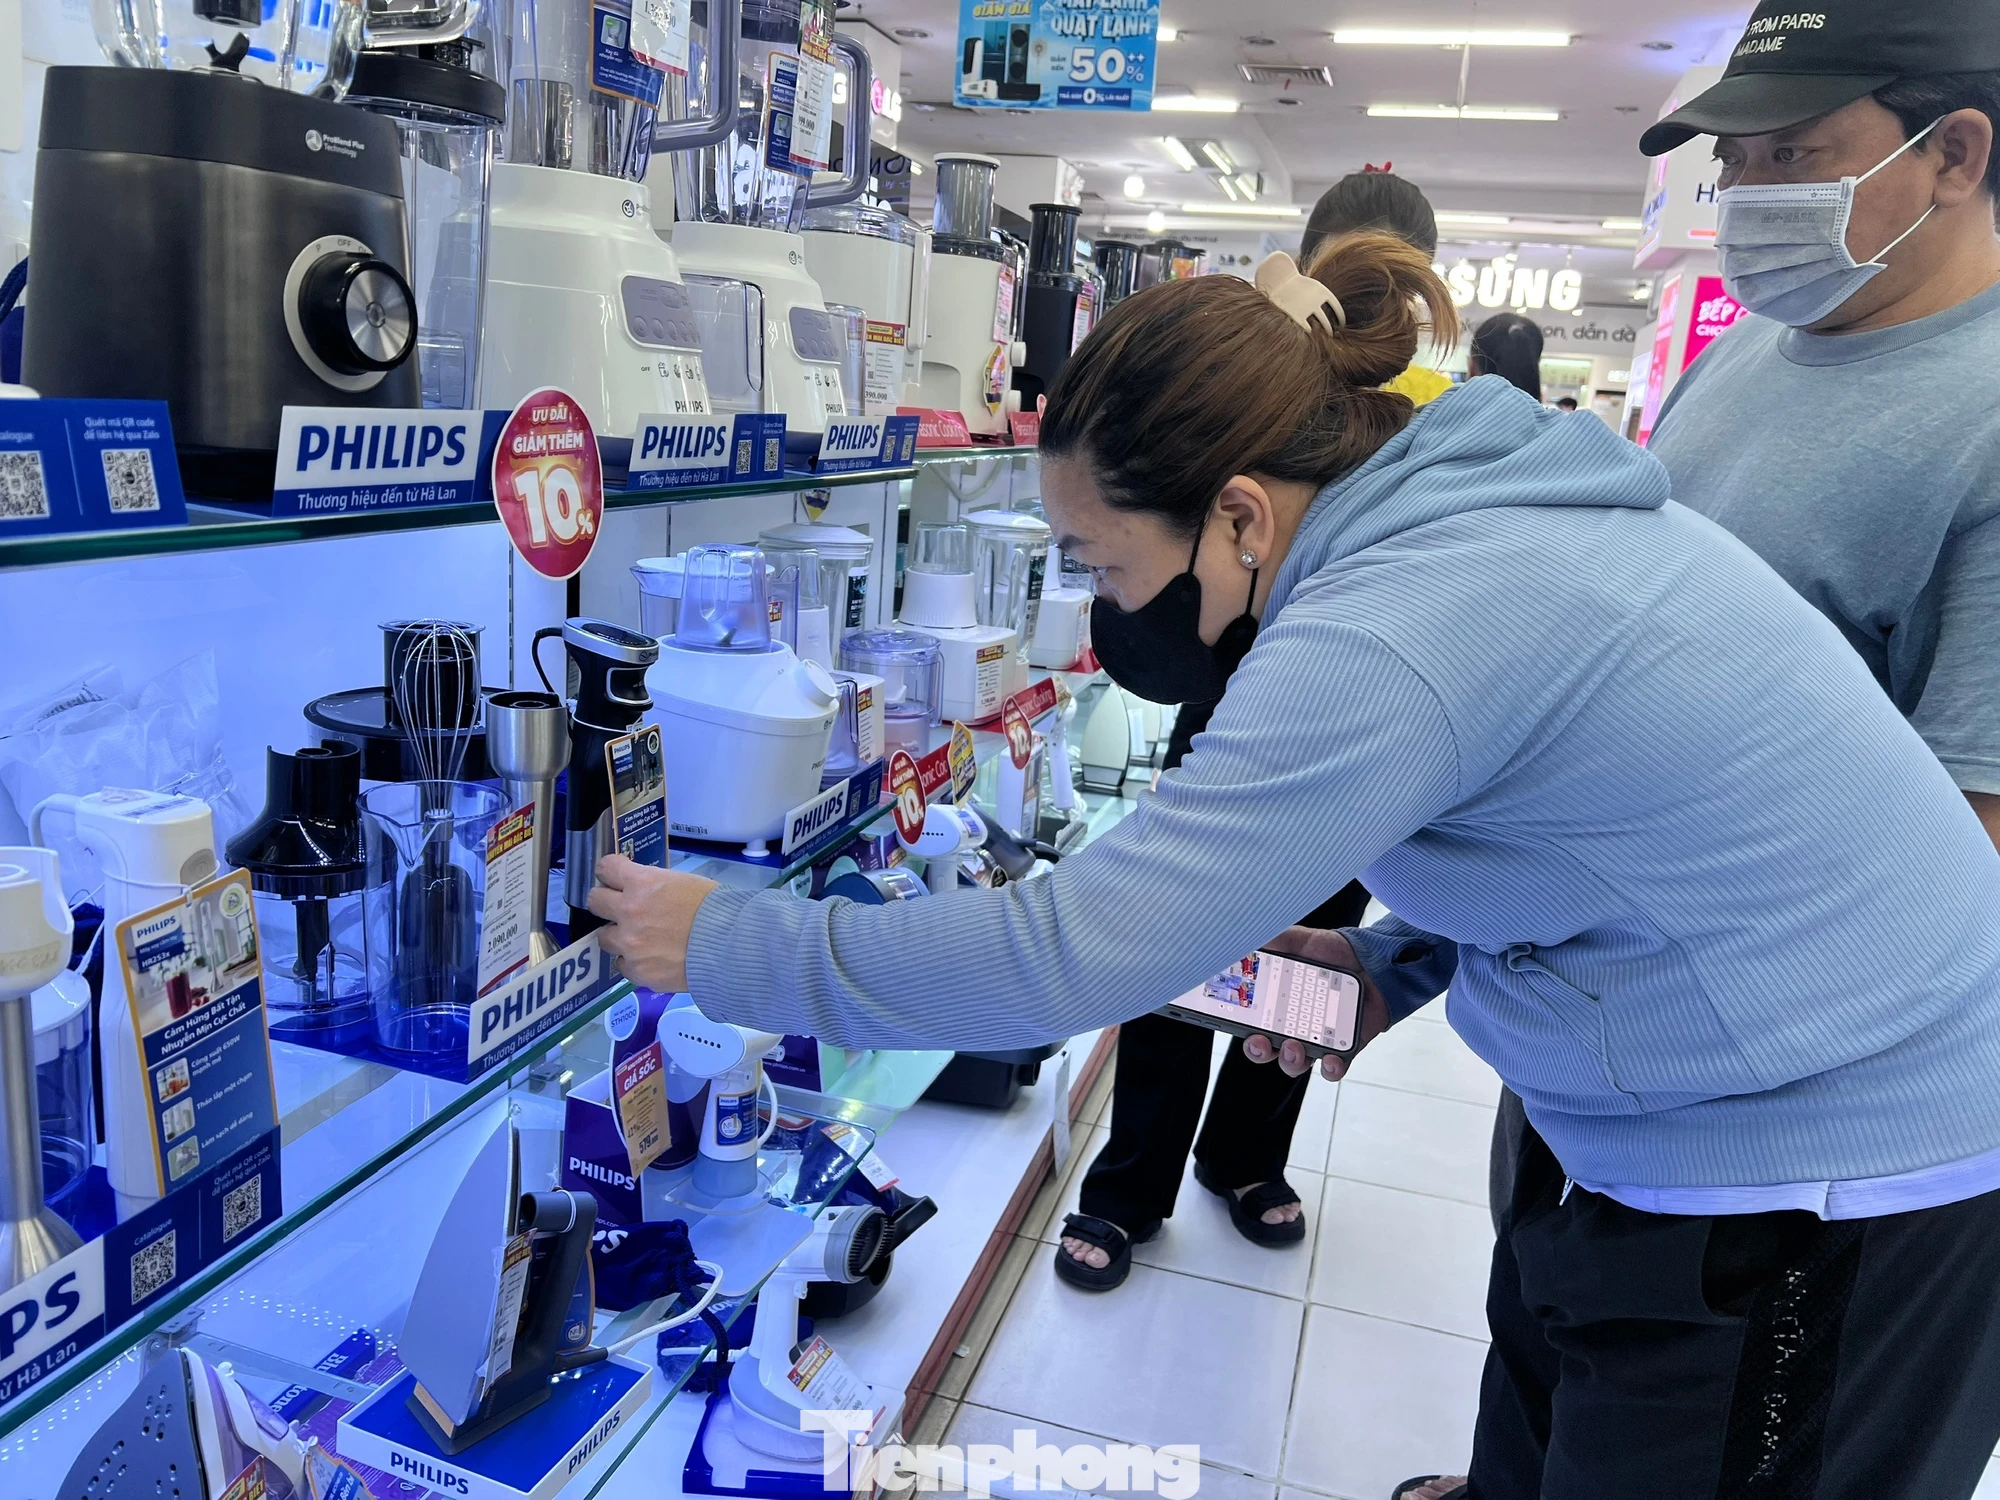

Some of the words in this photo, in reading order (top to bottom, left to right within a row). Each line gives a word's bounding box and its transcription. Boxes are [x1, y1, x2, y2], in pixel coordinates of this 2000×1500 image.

[1051, 14, 1099, 41] QUẠT
[1102, 14, 1150, 42] LẠNH
[1747, 16, 1779, 36] FROM
[1779, 13, 1826, 29] PARIS
[549, 403, 567, 421] ĐÃI
[296, 425, 466, 472] PHILIPS
[513, 432, 546, 454] GIẢM
[549, 430, 583, 451] THÊM
[641, 425, 726, 459] PHILIPS
[826, 424, 880, 451] PHILIPS
[298, 493, 348, 511] Thương
[351, 491, 378, 509] hiệu
[381, 487, 403, 504] đến
[406, 488, 419, 502] từ
[421, 487, 435, 501] Hà
[438, 487, 456, 500] Lan
[792, 791, 844, 844] PHILIPS
[137, 915, 176, 939] PHILIPS
[488, 924, 518, 953] 2.090.000
[141, 951, 170, 968] HR253x
[481, 946, 591, 1044] PHILIPS
[161, 1031, 196, 1056] Nhuyễn
[196, 1021, 213, 1040] Mịn
[214, 1013, 228, 1029] Cực
[228, 1001, 246, 1019] Chất
[164, 1023, 184, 1041] Cảm
[186, 1010, 210, 1031] Hứng
[211, 1001, 225, 1018] Bất
[226, 993, 241, 1009] Tận
[483, 1039, 515, 1069] Thương
[518, 1026, 536, 1048] hiệu
[537, 1013, 552, 1033] đến
[563, 1002, 573, 1018] Hà
[574, 992, 588, 1011] Lan
[611, 1008, 637, 1028] STH1000
[624, 1071, 638, 1091] GIÁ
[638, 1057, 656, 1081] SỐC
[569, 1156, 636, 1191] PHILIPS
[133, 1216, 173, 1248] Catalogue
[17, 1363, 41, 1389] Hà
[46, 1341, 77, 1370] Lan
[568, 1410, 620, 1475] PHILIPS
[390, 1451, 469, 1496] PHILIPS
